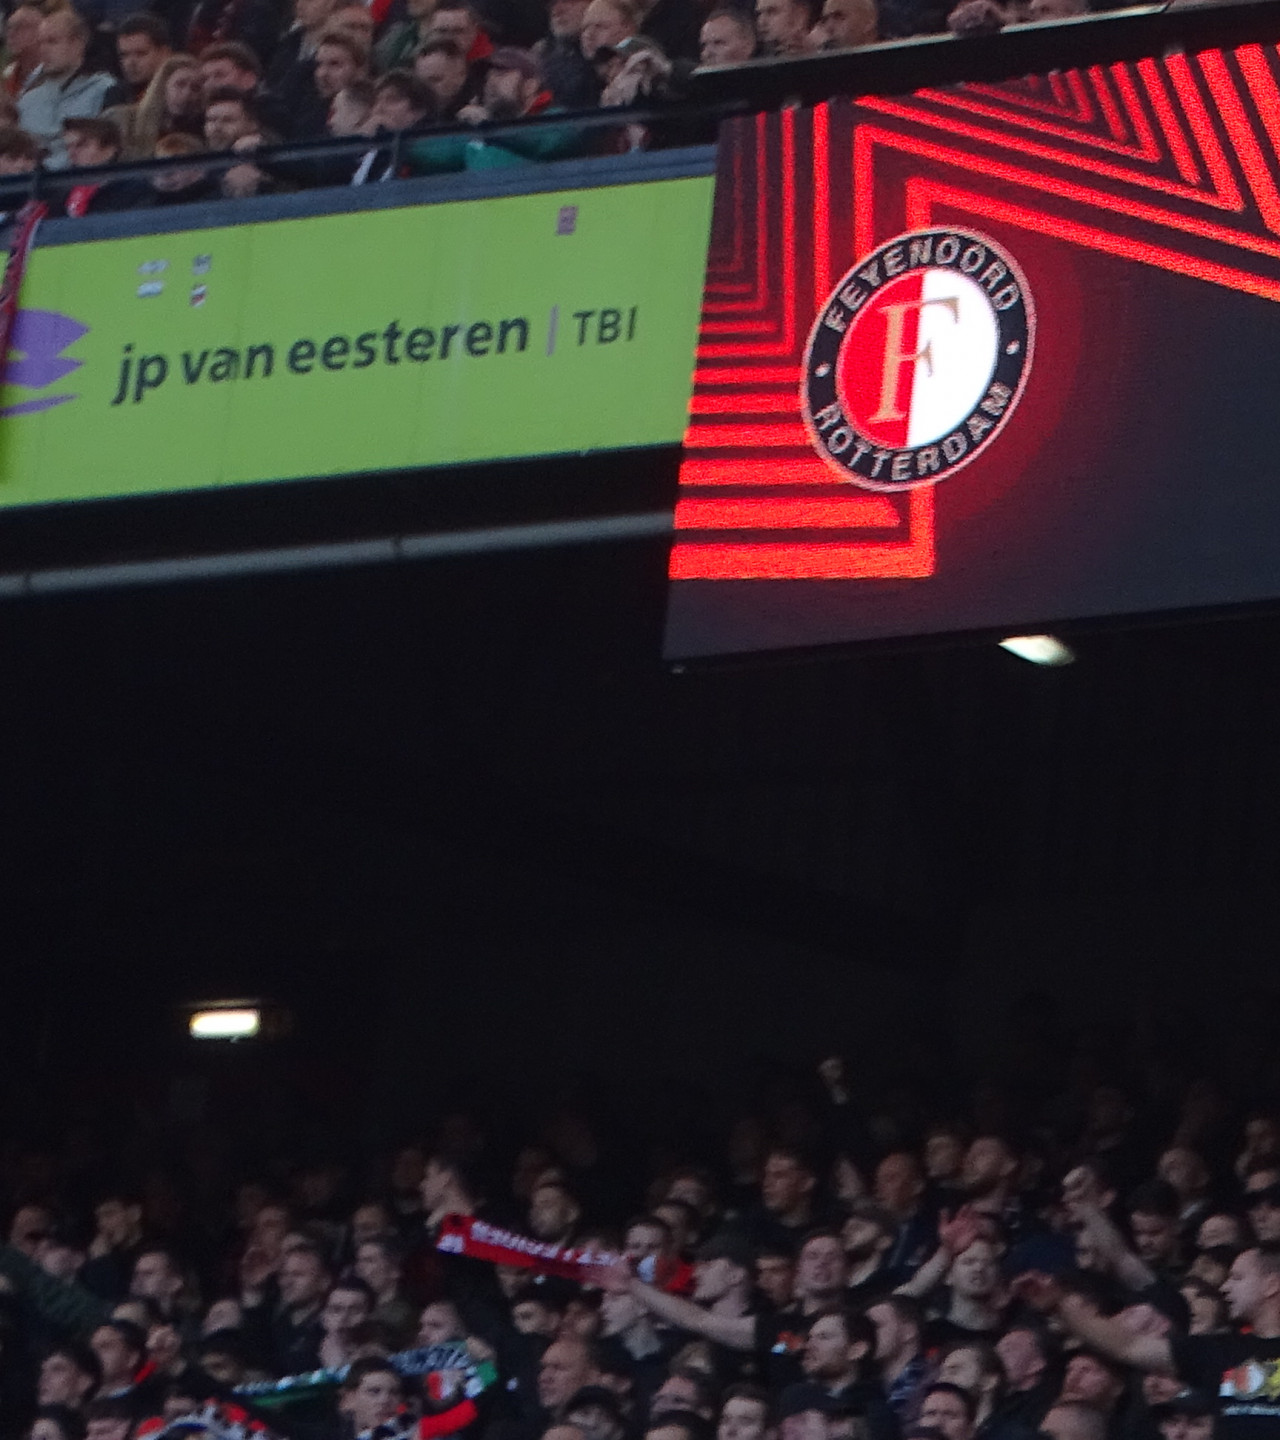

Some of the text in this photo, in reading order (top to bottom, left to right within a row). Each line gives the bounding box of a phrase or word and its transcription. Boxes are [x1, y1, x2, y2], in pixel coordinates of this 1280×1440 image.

[825, 235, 1020, 334] FEYENOORD
[110, 304, 639, 406] jp van eesteren TBI
[813, 380, 1012, 481] ROTTERDAM
